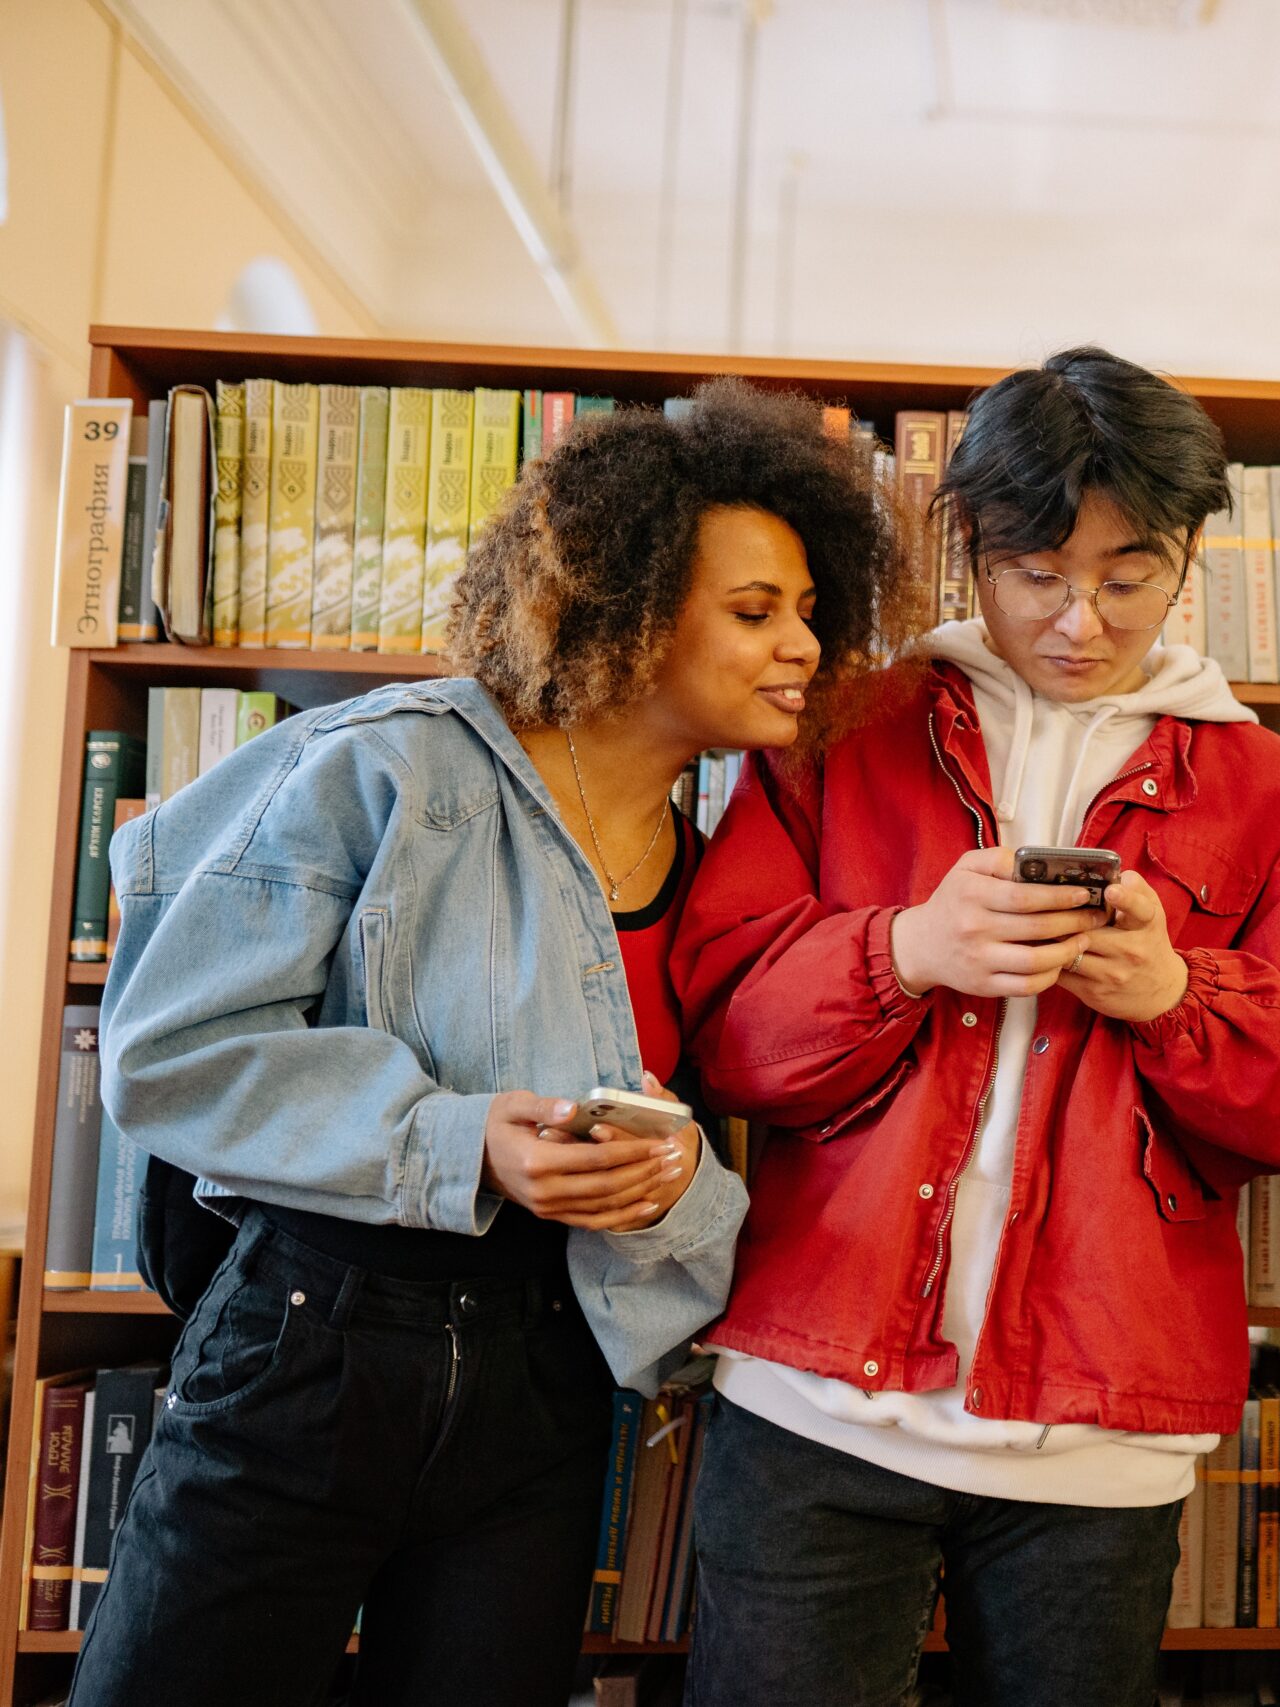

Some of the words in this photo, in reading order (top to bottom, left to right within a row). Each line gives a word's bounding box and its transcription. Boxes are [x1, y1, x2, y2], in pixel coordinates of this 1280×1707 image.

[84, 420, 119, 442] 39
[76, 462, 113, 636] Этнография
[47, 1431, 60, 1466] ГЕРОИ
[59, 1423, 73, 1474] ЭЛЛАДЫ
[615, 1423, 629, 1472] ЛЕГЕНДЫ
[611, 1488, 622, 1523] МИФЫ
[606, 1526, 618, 1569] ДРЕВНЕ
[601, 1586, 612, 1624] РЕЦИИ
